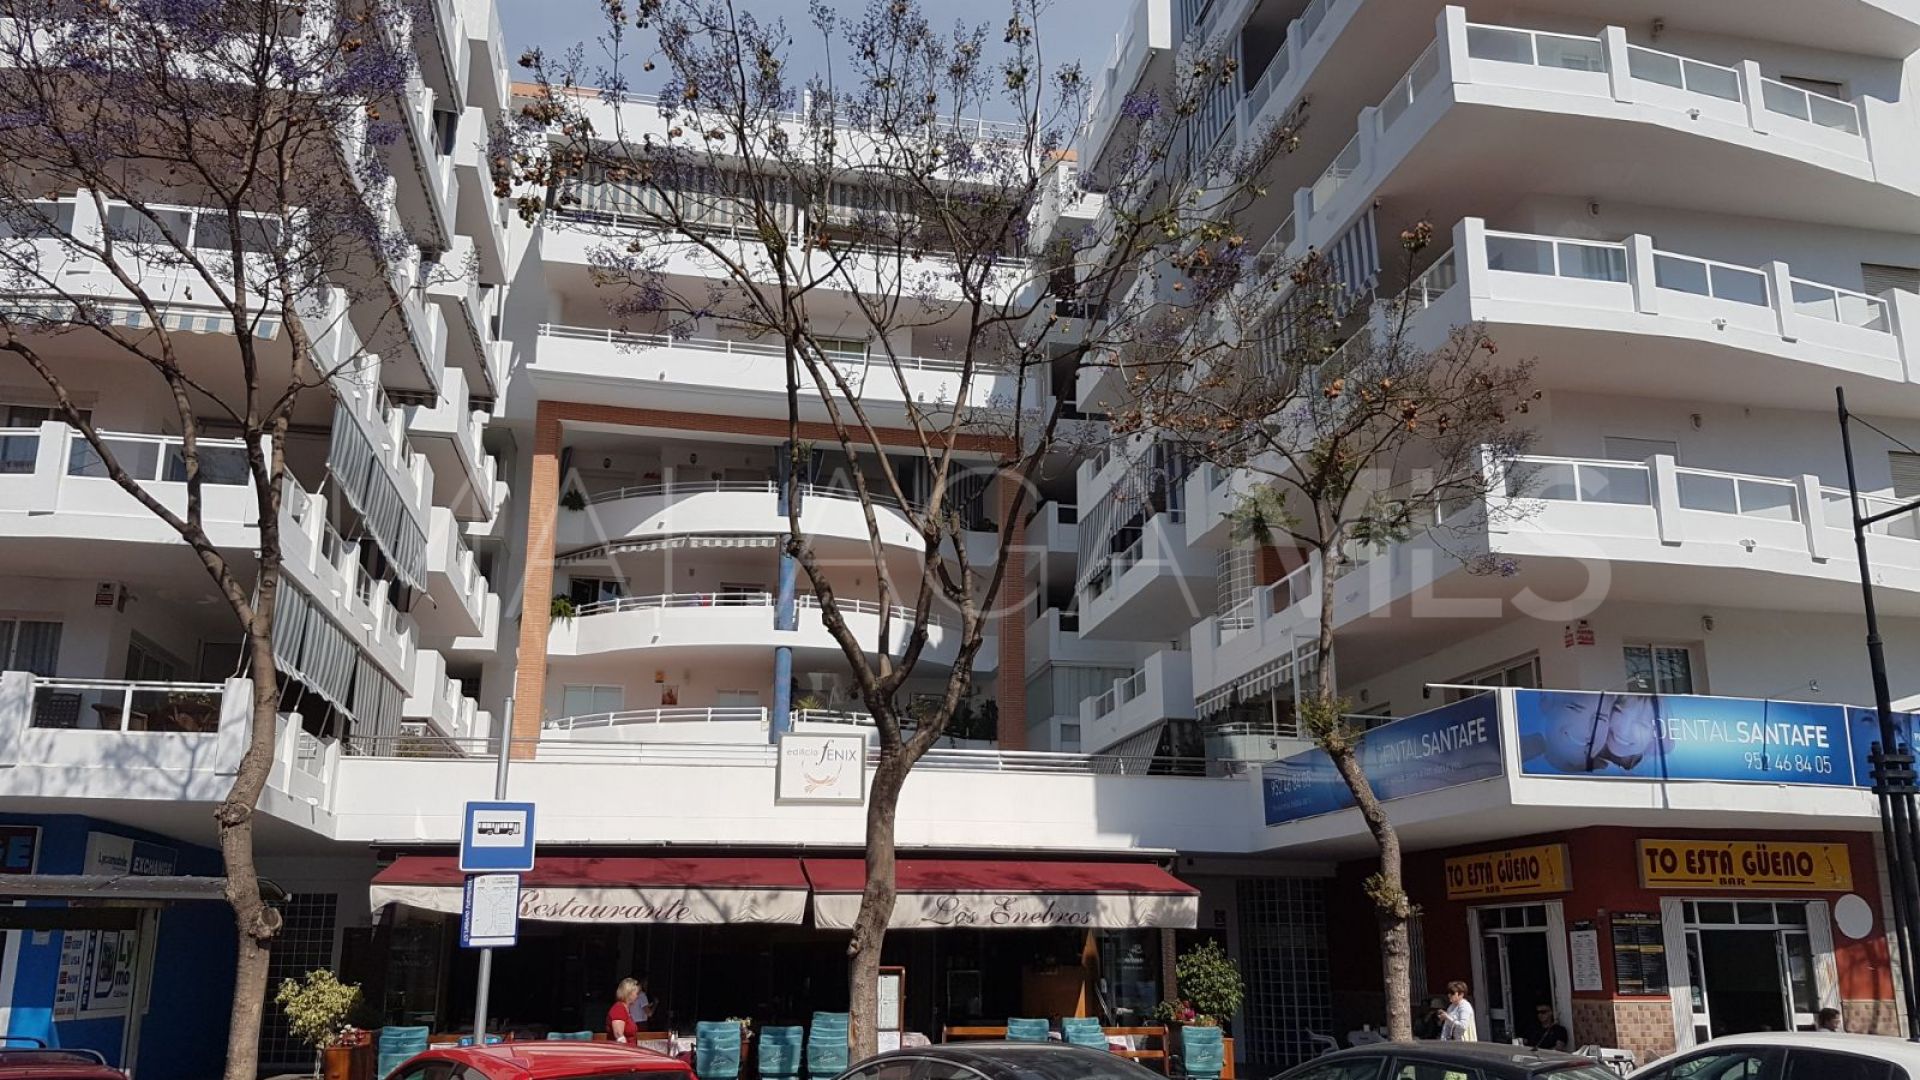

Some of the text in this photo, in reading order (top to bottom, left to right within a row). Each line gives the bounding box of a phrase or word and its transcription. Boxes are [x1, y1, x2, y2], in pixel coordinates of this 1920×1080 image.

[1744, 751, 1832, 774] 952 46 84 05
[1447, 850, 1540, 887] TO ESTÁ GÜENO
[1645, 843, 1815, 877] TO ESTÁ GÜENO
[1719, 877, 1746, 886] BAR
[518, 889, 691, 920] Restaurante
[921, 895, 1092, 926] Los Enebros
